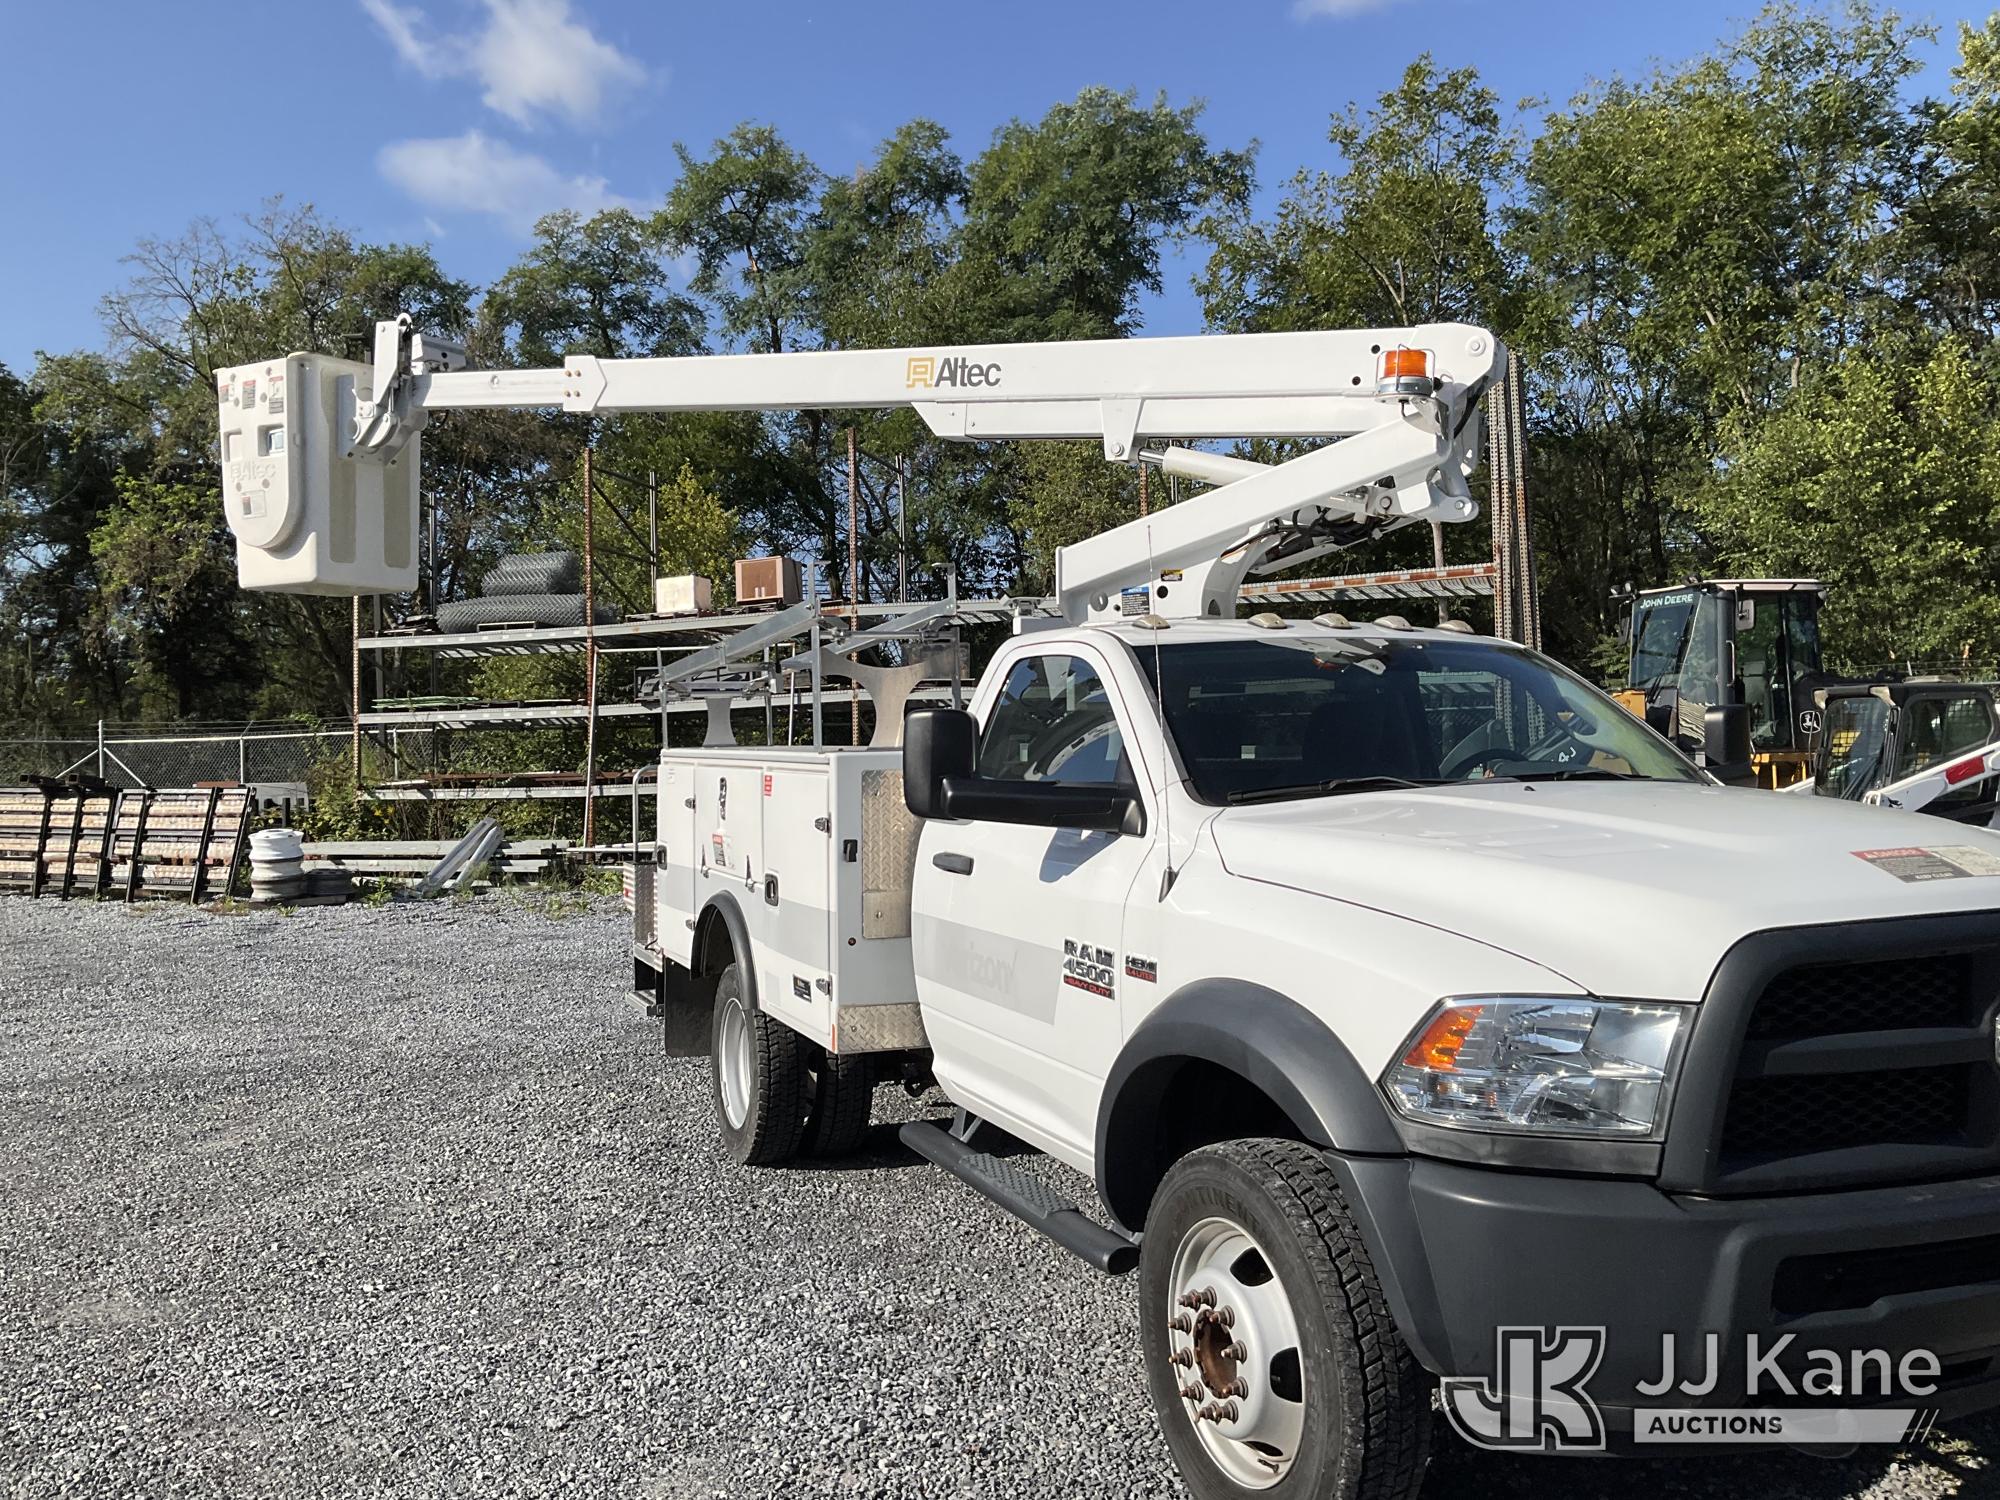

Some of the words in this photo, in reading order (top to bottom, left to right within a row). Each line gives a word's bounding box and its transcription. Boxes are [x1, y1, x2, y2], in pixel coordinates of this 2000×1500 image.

[934, 357, 1002, 388] Altec
[1640, 598, 1663, 609] JOHN
[1664, 594, 1694, 605] DEERE
[1063, 938, 1115, 969] RAM
[1062, 957, 1115, 988] 4500
[1065, 974, 1089, 990] HEAVY
[1088, 983, 1111, 998] DUTY
[1137, 970, 1155, 982] LITER
